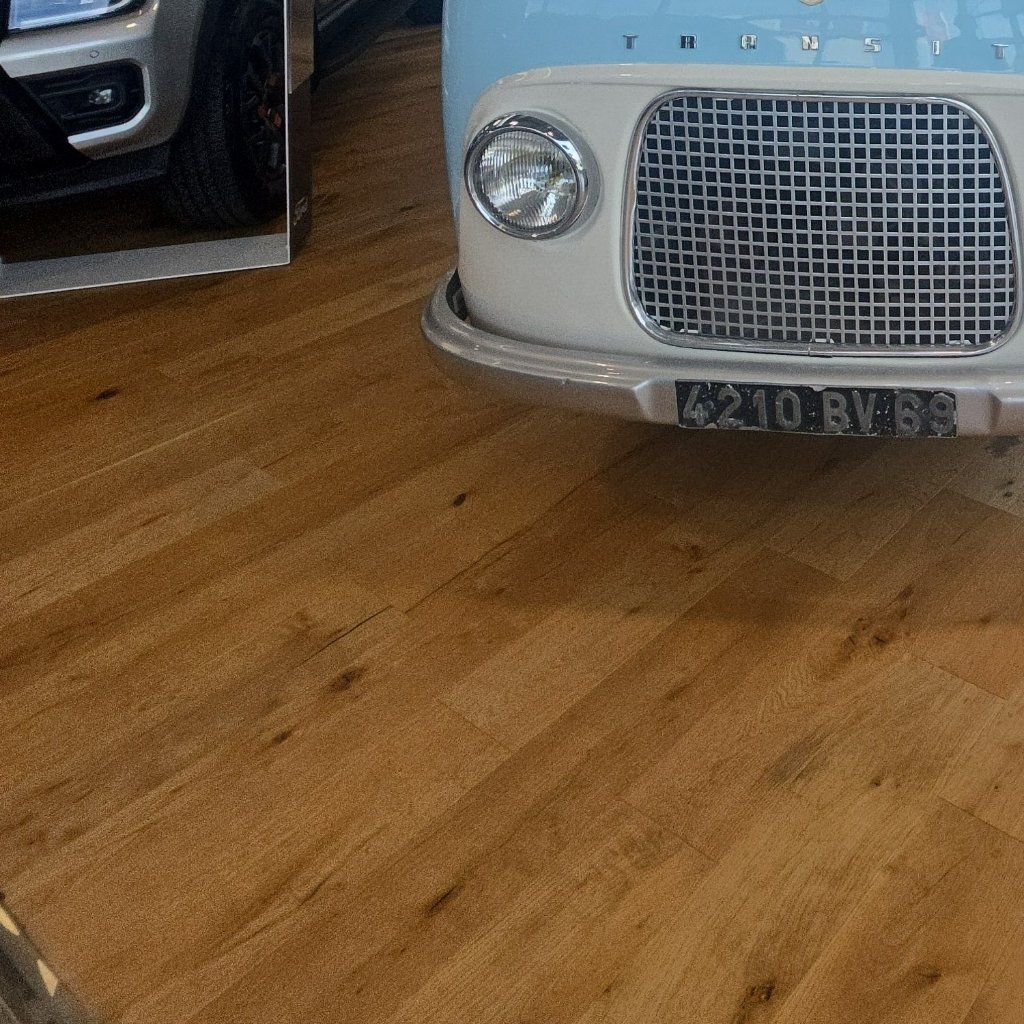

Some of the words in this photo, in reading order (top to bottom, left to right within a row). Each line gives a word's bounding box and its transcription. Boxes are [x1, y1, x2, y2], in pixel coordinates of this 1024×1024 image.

[622, 33, 1009, 60] TRANSIT
[682, 384, 801, 432] 4210
[822, 390, 877, 434] BV
[895, 391, 955, 435] 69
